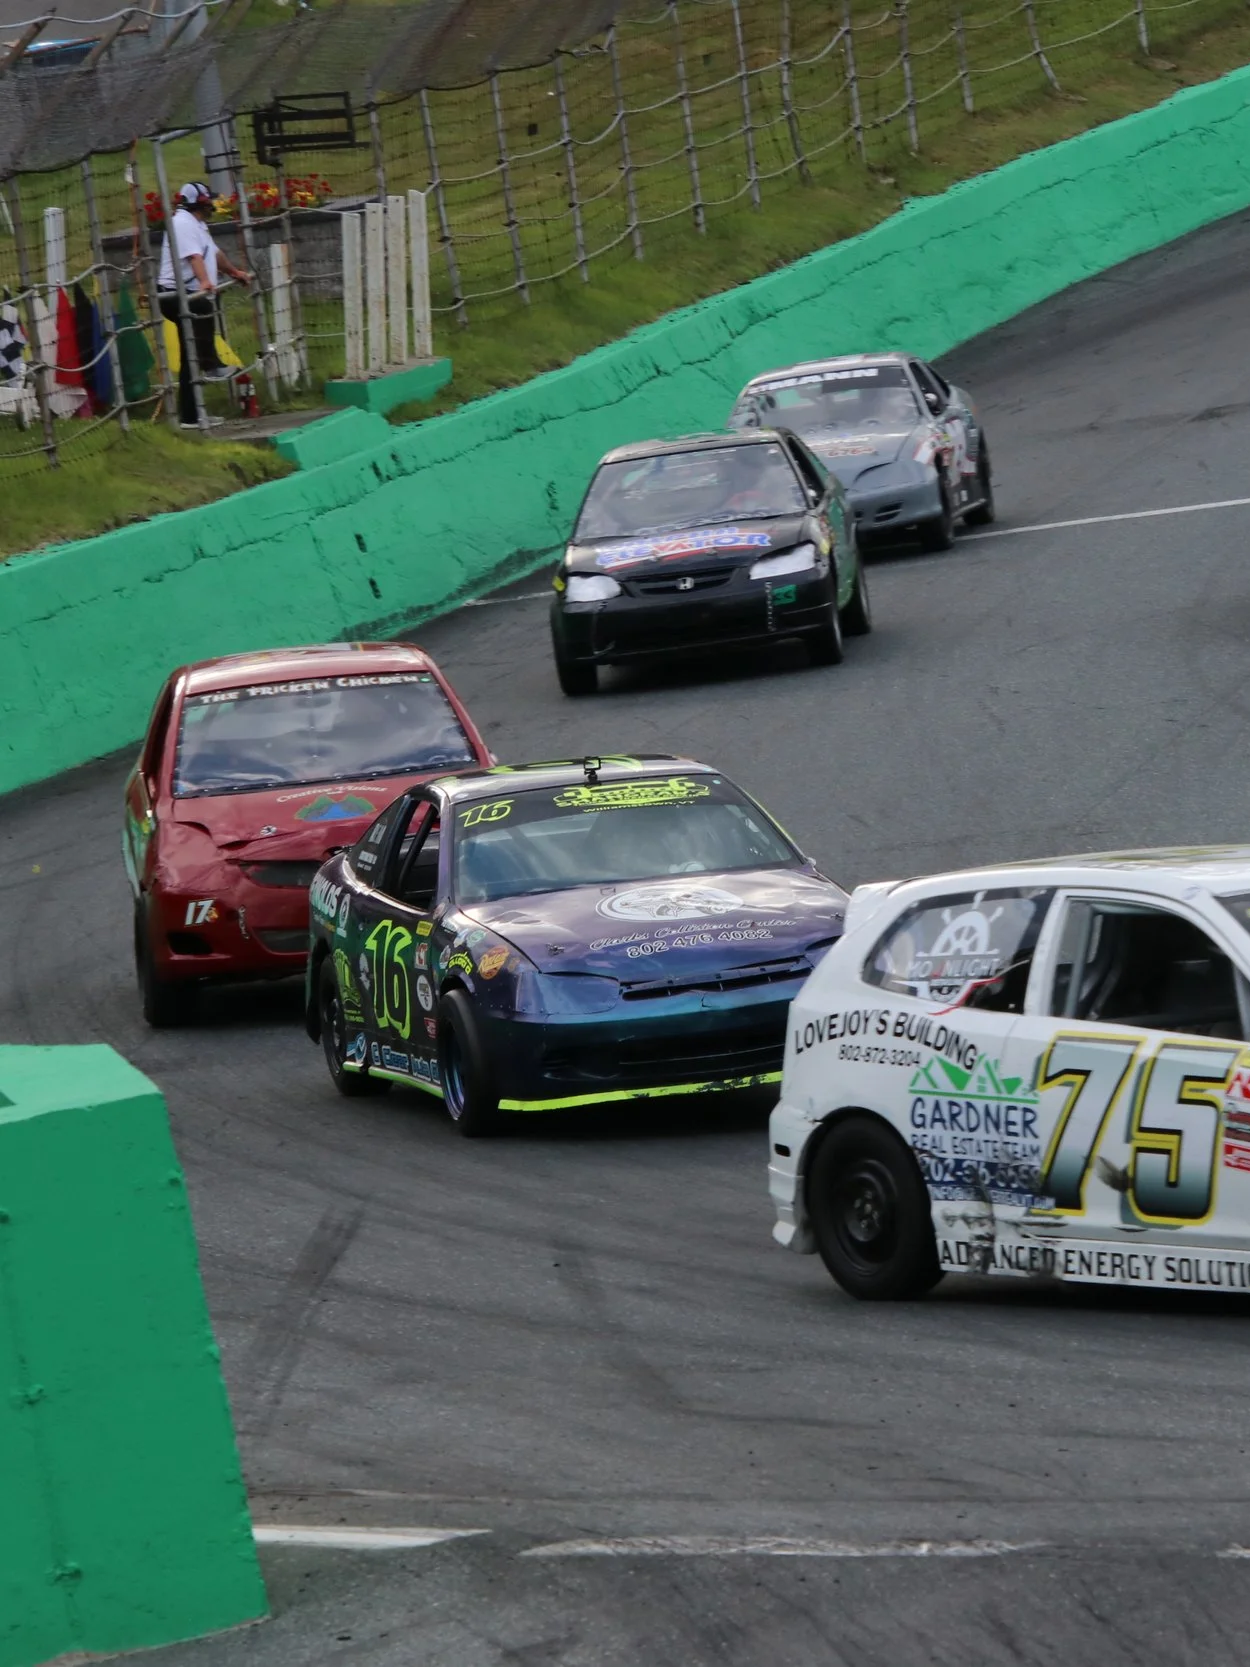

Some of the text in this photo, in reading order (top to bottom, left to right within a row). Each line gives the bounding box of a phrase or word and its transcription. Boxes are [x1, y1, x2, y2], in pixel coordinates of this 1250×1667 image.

[200, 690, 239, 704] THE
[459, 800, 515, 828] 16
[184, 899, 214, 926] 17
[627, 928, 774, 959] 802 476 4082
[365, 919, 412, 1040] 16
[794, 1009, 978, 1071] LOVEJOY'S BUILDING
[838, 1043, 921, 1067] 802-872-3204
[911, 1096, 1039, 1139] GARDNER
[1032, 1030, 1248, 1226] 75
[911, 1134, 947, 1154] REAL
[952, 1136, 999, 1160] ESTATE
[940, 1240, 1057, 1273] ADANCED
[1063, 1248, 1156, 1280] ENERGY
